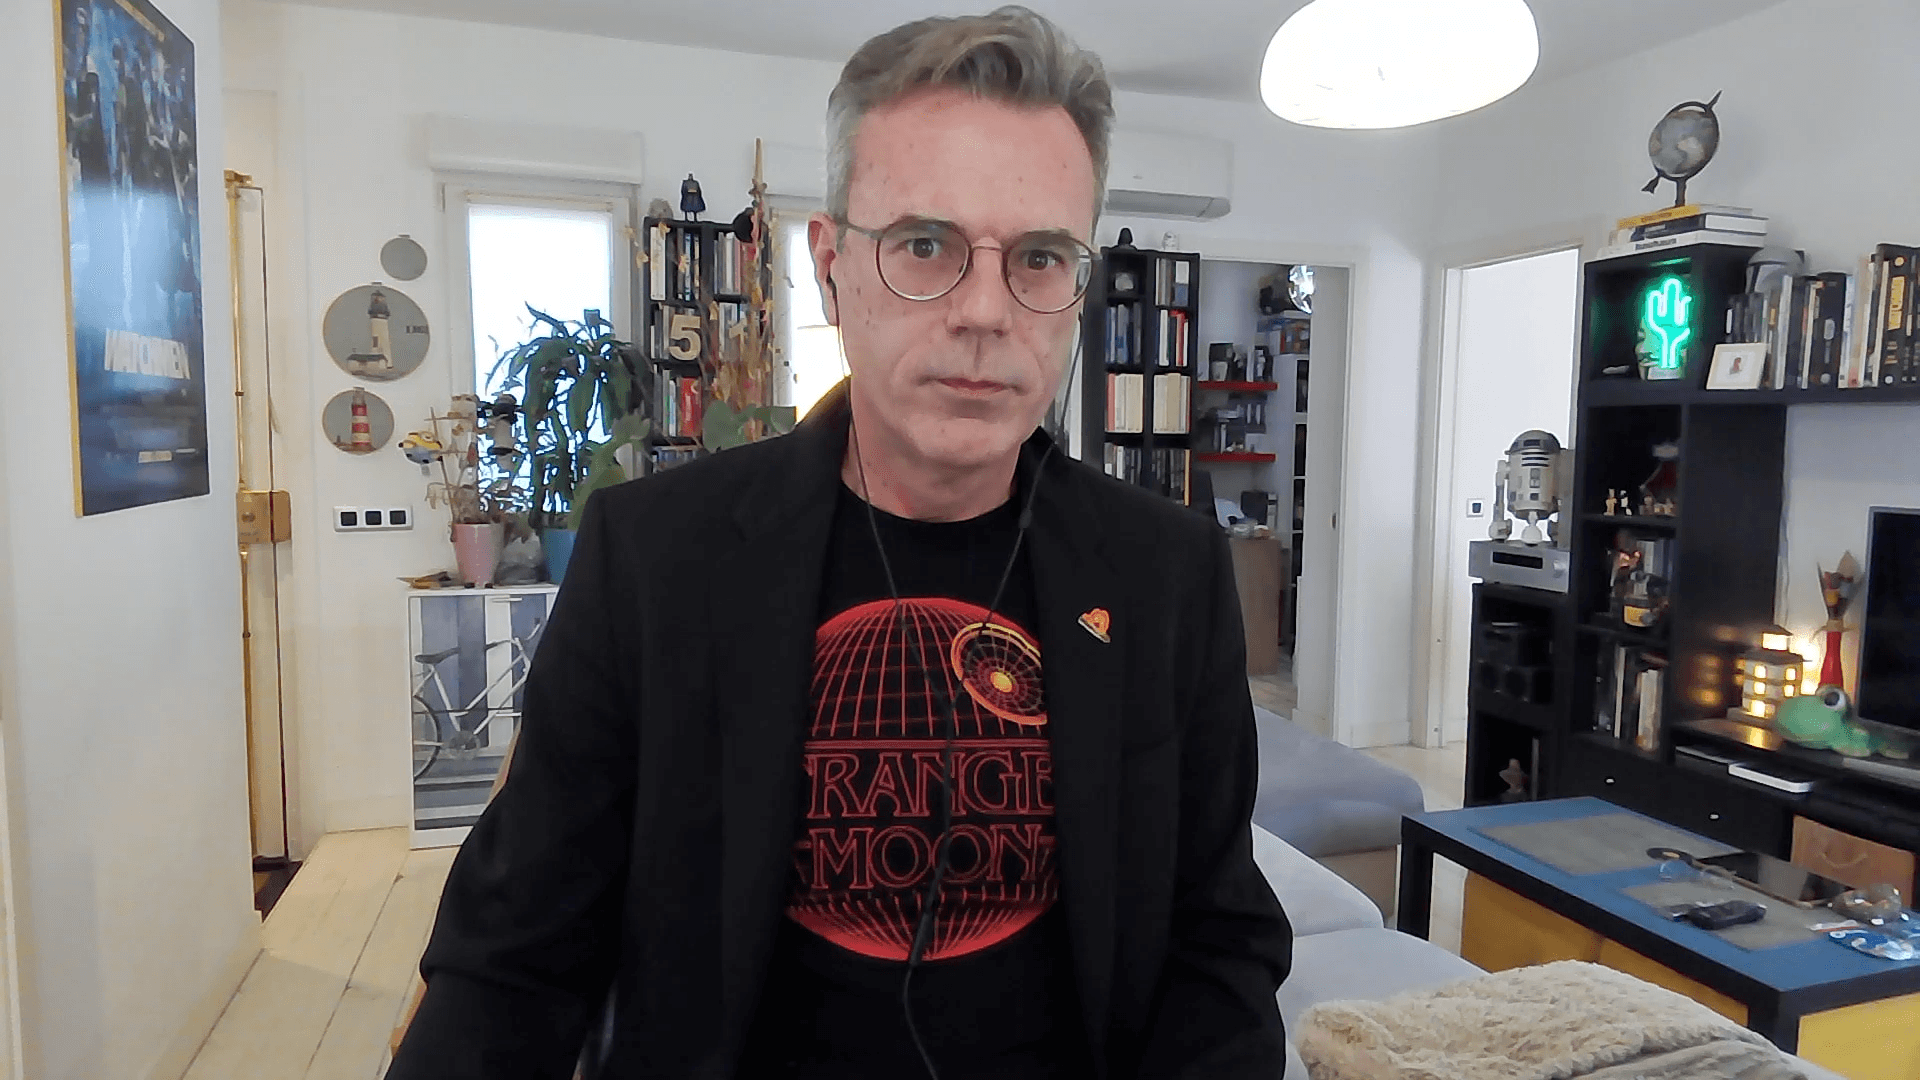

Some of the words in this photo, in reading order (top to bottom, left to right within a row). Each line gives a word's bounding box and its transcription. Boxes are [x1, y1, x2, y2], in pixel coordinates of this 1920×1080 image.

[669, 314, 701, 361] 5
[804, 751, 1054, 818] RANGE
[808, 824, 1042, 890] MOON
